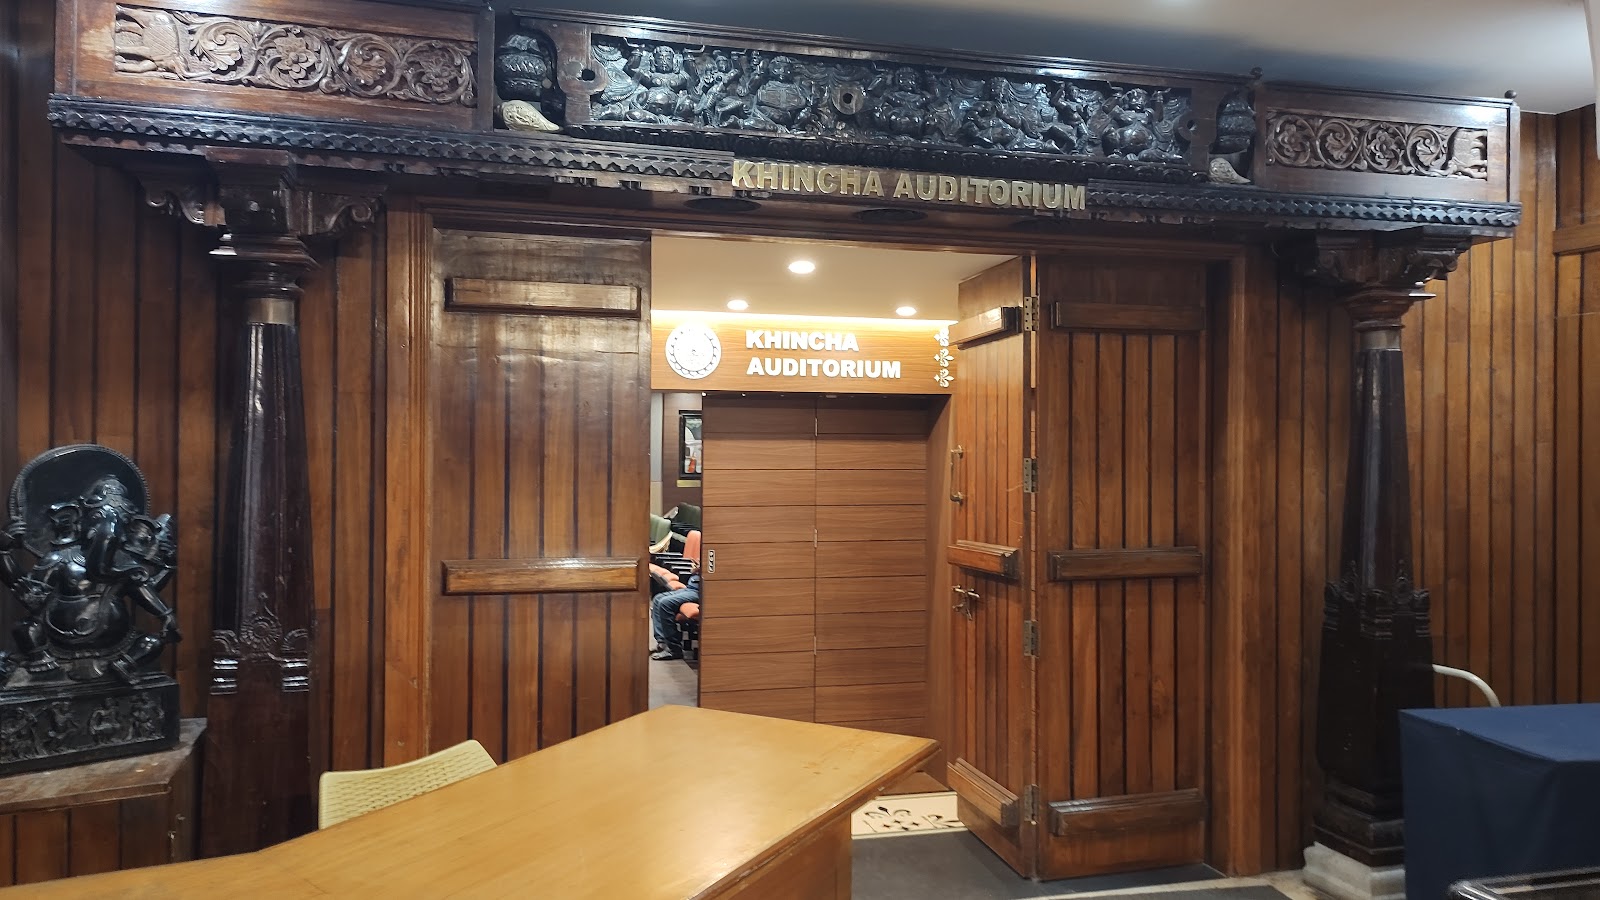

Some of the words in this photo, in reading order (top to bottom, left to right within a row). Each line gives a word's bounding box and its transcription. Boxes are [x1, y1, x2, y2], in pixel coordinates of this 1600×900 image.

[732, 160, 885, 197] KHINCHA
[893, 172, 1087, 211] AUDITORIUM
[745, 329, 860, 352] KHINCHA
[746, 356, 902, 379] AUDITORIUM
